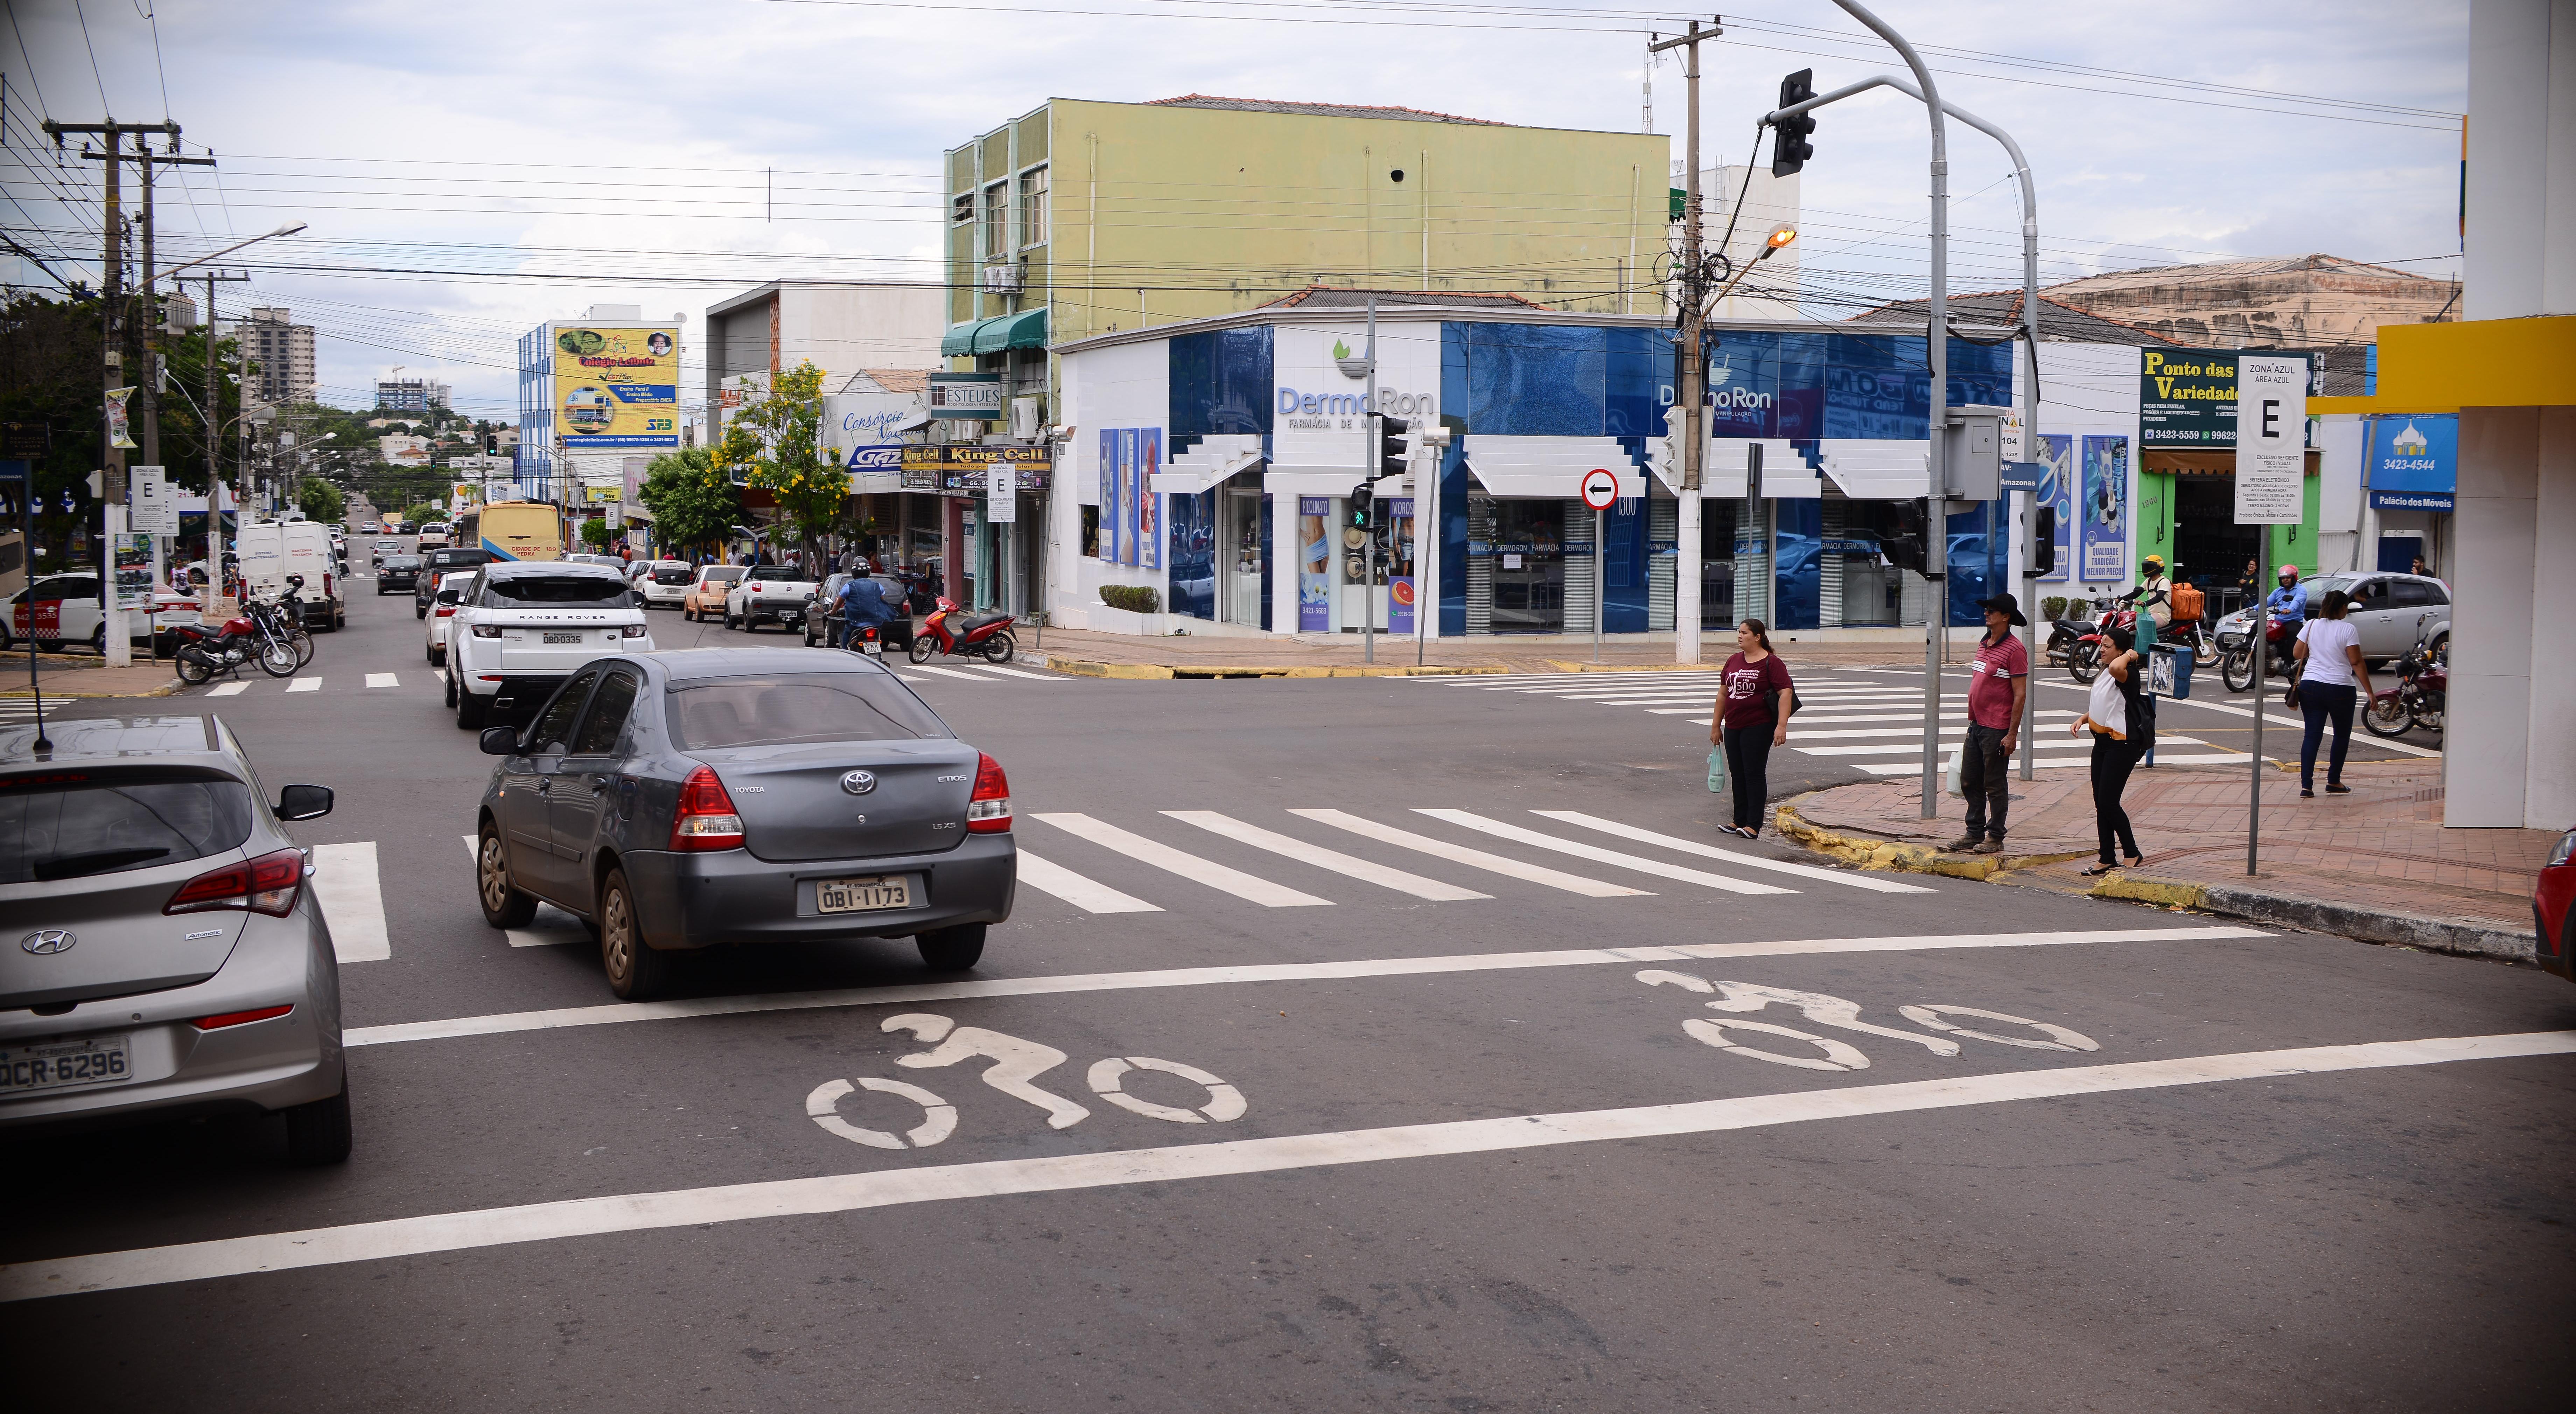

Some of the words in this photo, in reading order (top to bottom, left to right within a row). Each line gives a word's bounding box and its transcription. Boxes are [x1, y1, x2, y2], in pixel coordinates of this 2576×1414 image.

[618, 357, 654, 367] Leibniz
[2145, 353, 2201, 377] Ponto
[2205, 362, 2234, 377] das
[2250, 365, 2272, 373] ZONA
[2255, 374, 2272, 383] ÁREA
[947, 390, 1000, 402] ESTEVES
[1734, 387, 1771, 408] Ron
[646, 419, 672, 431] SFB
[843, 410, 904, 431] Consórcio
[1289, 416, 1331, 429] FARMÁCIA
[1341, 419, 1352, 429] DE
[2262, 400, 2280, 438] E
[2156, 430, 2199, 440] 3423-5559
[904, 448, 921, 463] King
[923, 448, 939, 460] Cell
[951, 448, 1000, 463] King
[1004, 448, 1043, 460] Cell
[2384, 459, 2435, 470] 3423-4544
[144, 482, 153, 497] E
[998, 479, 1005, 492] E
[1303, 500, 1328, 514] PICOLINATO
[1619, 497, 1636, 516] 1300
[2142, 496, 2157, 508] 1260
[2380, 496, 2407, 505] Palácio
[2408, 497, 2422, 506] dos
[2423, 497, 2451, 507] Móveis
[1532, 543, 1559, 551] FARMÁCIA
[2093, 548, 2119, 556] QUALIDADE
[2092, 556, 2115, 567] TRADIÇÃO
[2116, 557, 2119, 565] E
[2086, 567, 2105, 576] MELHOR
[2106, 567, 2123, 577] PREÇO!
[1737, 682, 1756, 691] 500
[188, 931, 220, 939] Automatic
